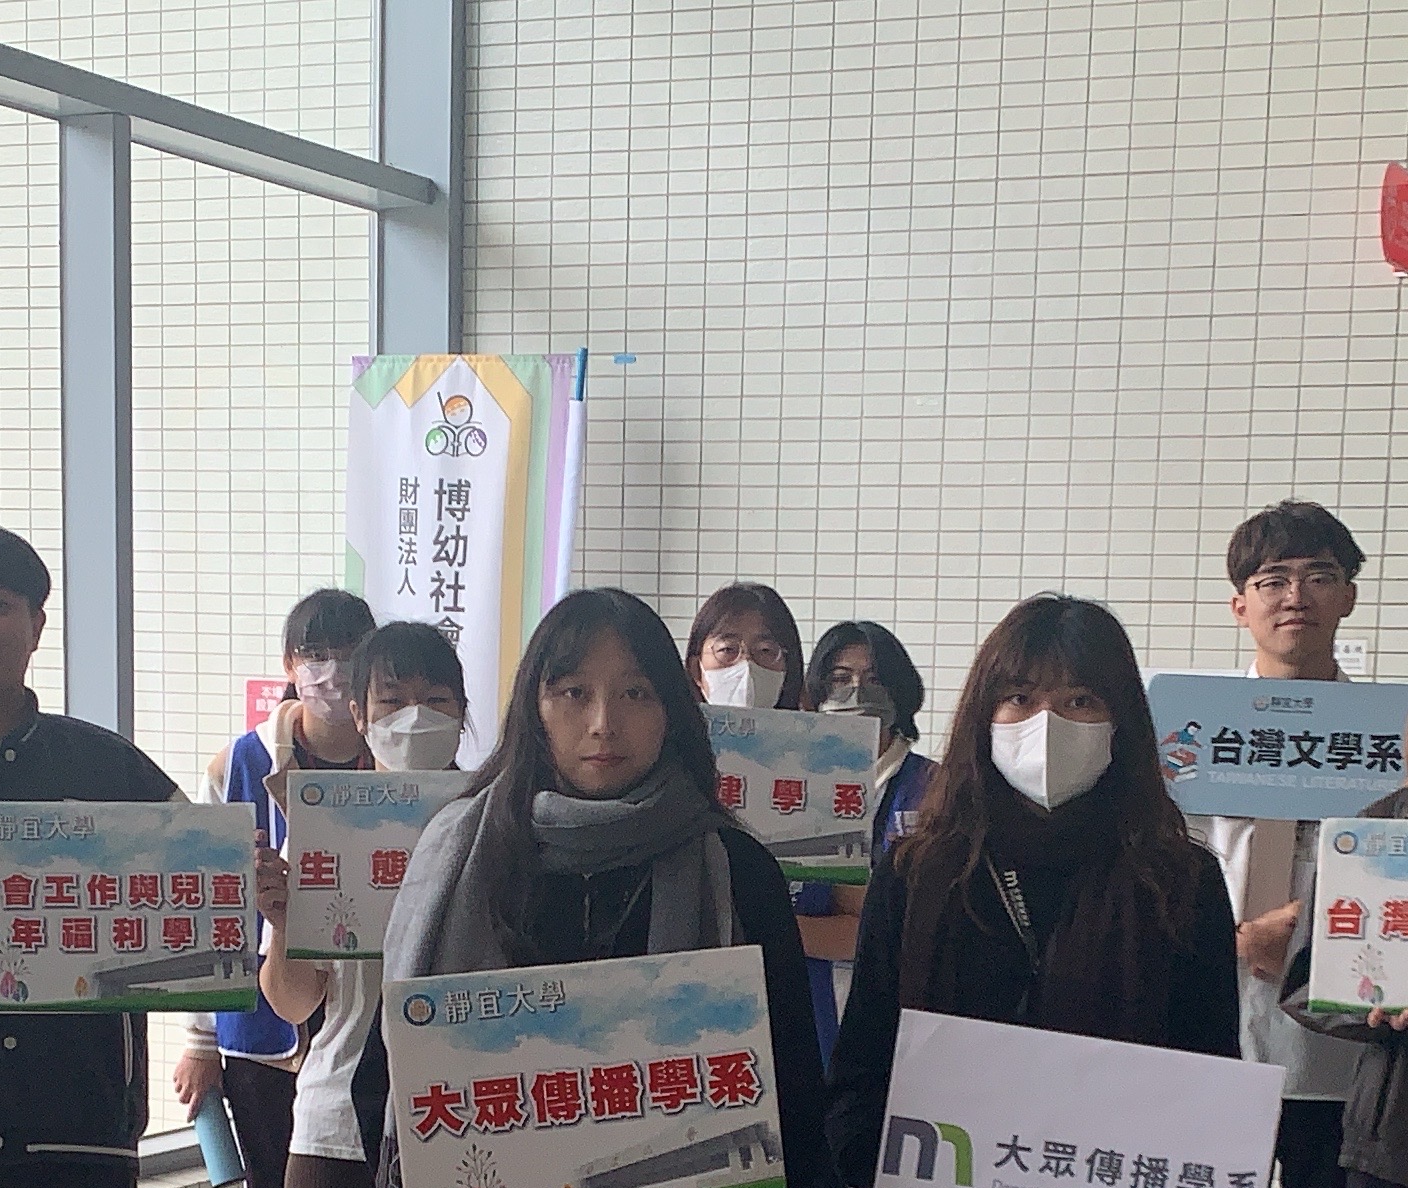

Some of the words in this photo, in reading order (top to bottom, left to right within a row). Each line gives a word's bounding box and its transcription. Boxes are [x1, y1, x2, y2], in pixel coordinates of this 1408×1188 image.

[397, 476, 420, 597] 財團法人
[1210, 725, 1403, 772] 台灣文學系
[332, 783, 419, 807] 靜宜大學
[443, 980, 567, 1024] 靜宜大學
[410, 1049, 763, 1138] 大眾傳播學系
